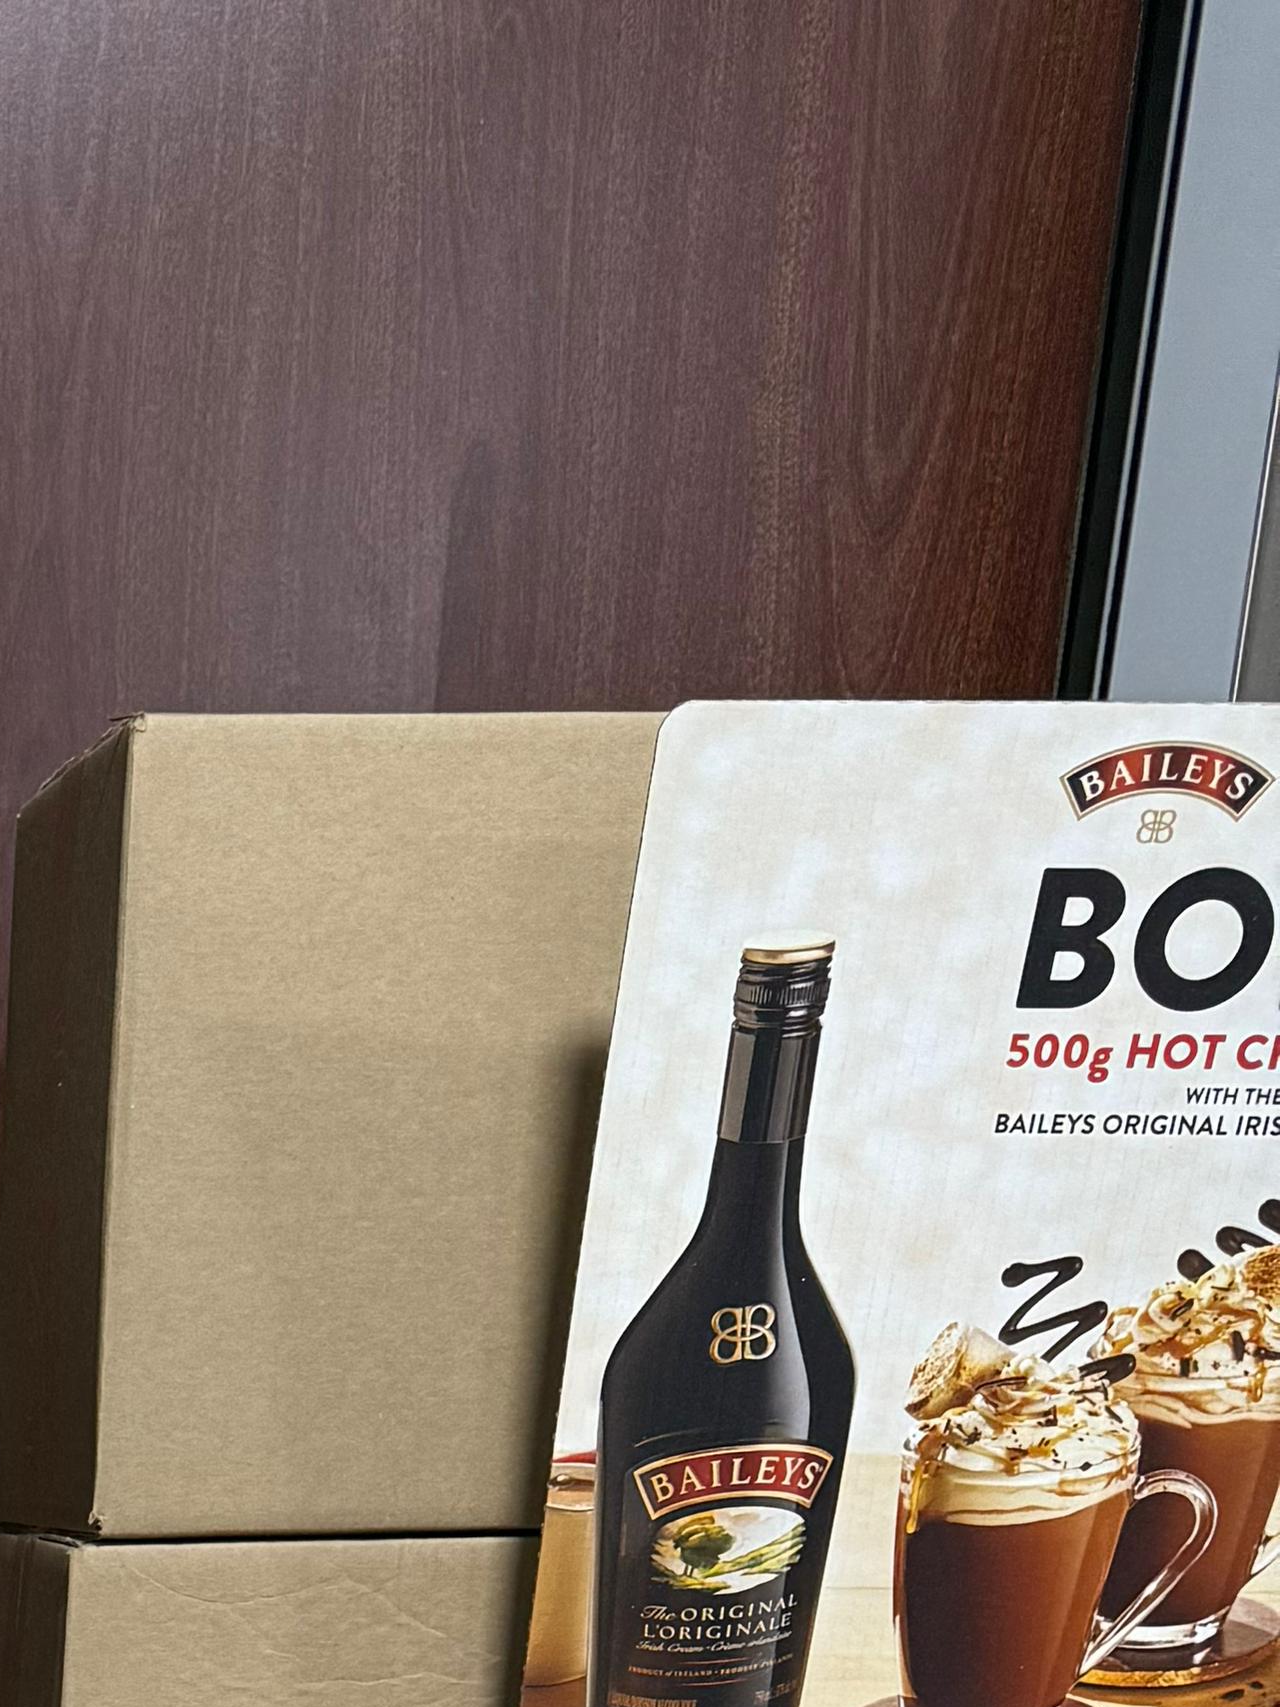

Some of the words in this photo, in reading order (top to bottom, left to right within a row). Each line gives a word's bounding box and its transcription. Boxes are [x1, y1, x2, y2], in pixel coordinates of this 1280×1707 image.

[1080, 745, 1253, 803] BAILEYS
[1006, 1034, 1113, 1083] 500g
[1126, 1034, 1227, 1069] HOT
[1186, 1088, 1239, 1104] WITH
[994, 1113, 1095, 1134] BAILEYS
[1103, 1115, 1228, 1136] ORIGINAL
[649, 1456, 818, 1503] BAILEYS
[640, 1605, 676, 1620] The
[680, 1593, 798, 1621] ORIGINAL
[643, 1612, 793, 1641] L'ORIGINALE
